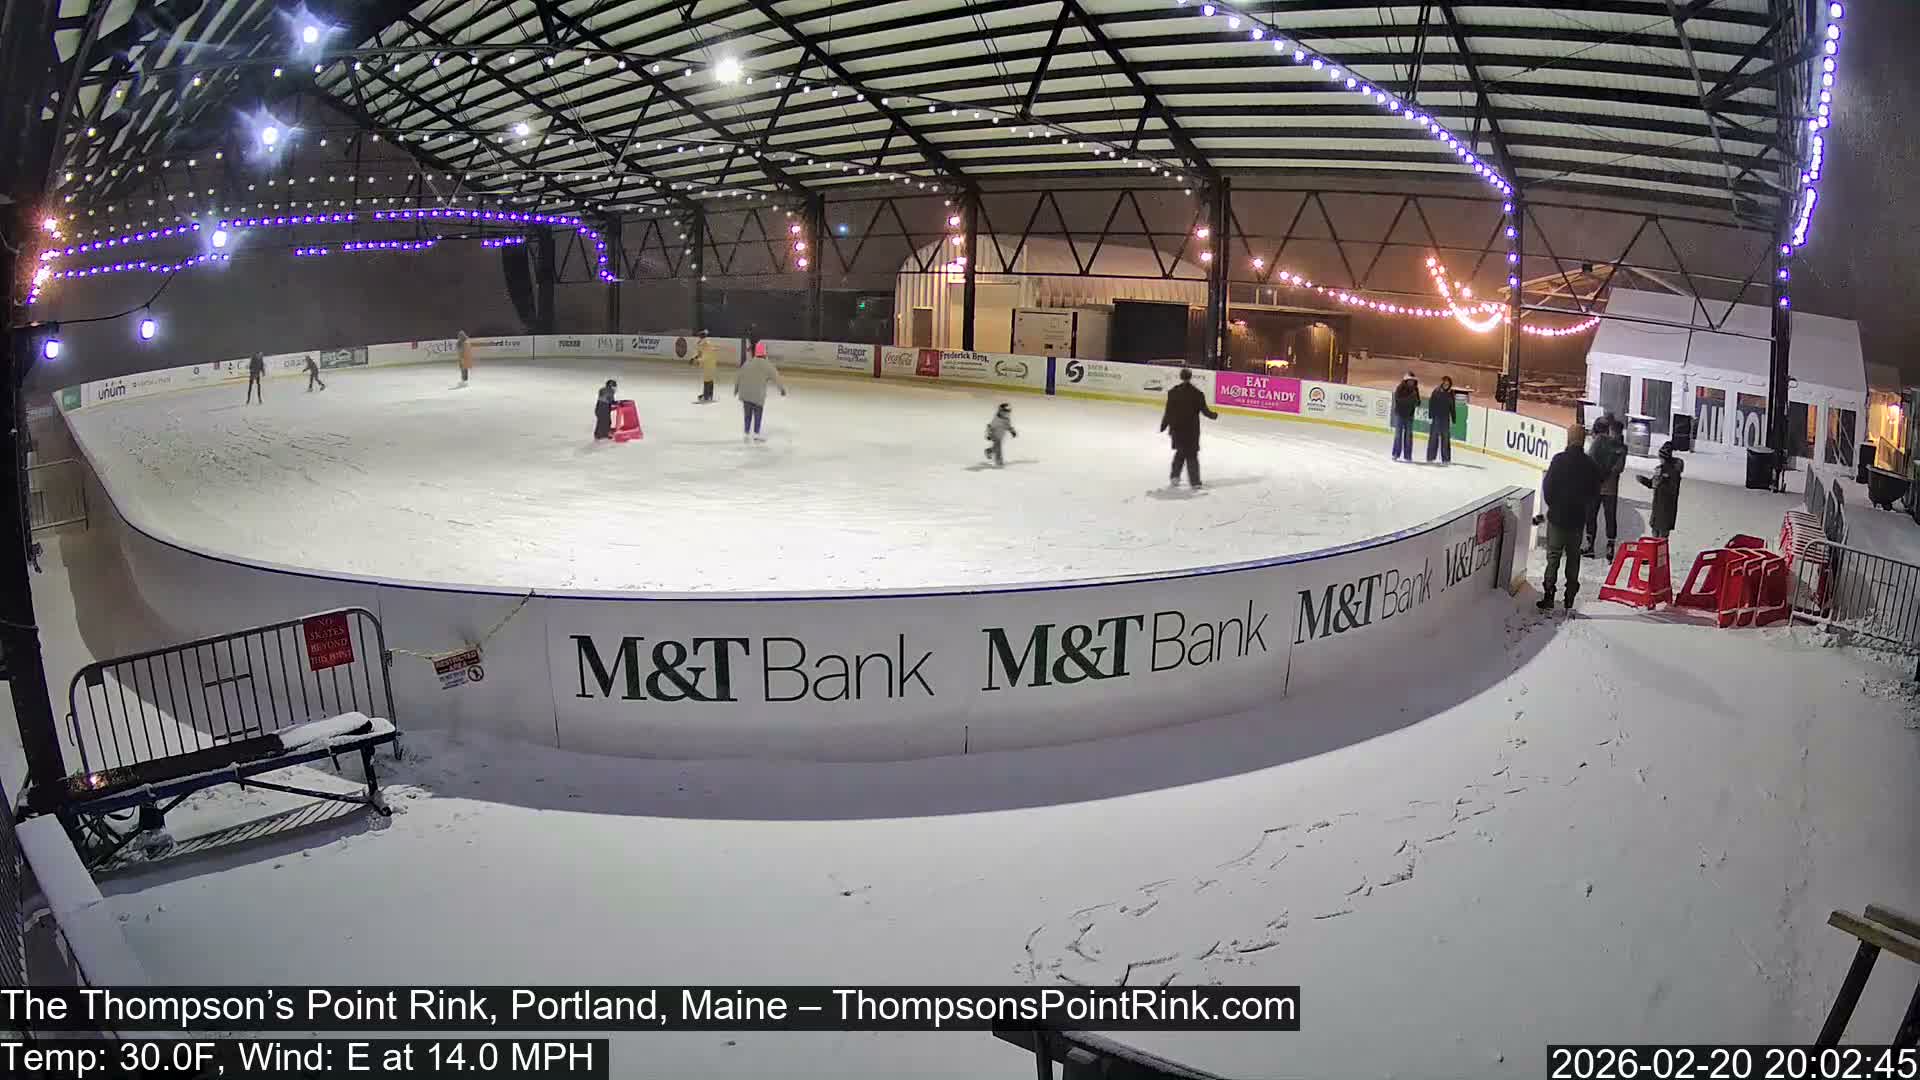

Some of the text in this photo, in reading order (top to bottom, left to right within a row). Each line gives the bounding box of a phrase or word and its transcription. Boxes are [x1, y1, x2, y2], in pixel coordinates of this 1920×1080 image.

[838, 344, 867, 357] Bangor
[939, 350, 969, 360] Frederick
[1246, 376, 1269, 388] EAT
[98, 382, 126, 400] unum
[1258, 389, 1296, 402] CANDY
[1506, 425, 1549, 460] unum
[1441, 535, 1476, 592] M&T
[1294, 557, 1433, 645] M&T Bank
[310, 627, 345, 640] SKATES
[310, 639, 348, 652] BEYOND
[982, 599, 1269, 691] M&T Bank
[570, 633, 935, 702] M&T Bank
